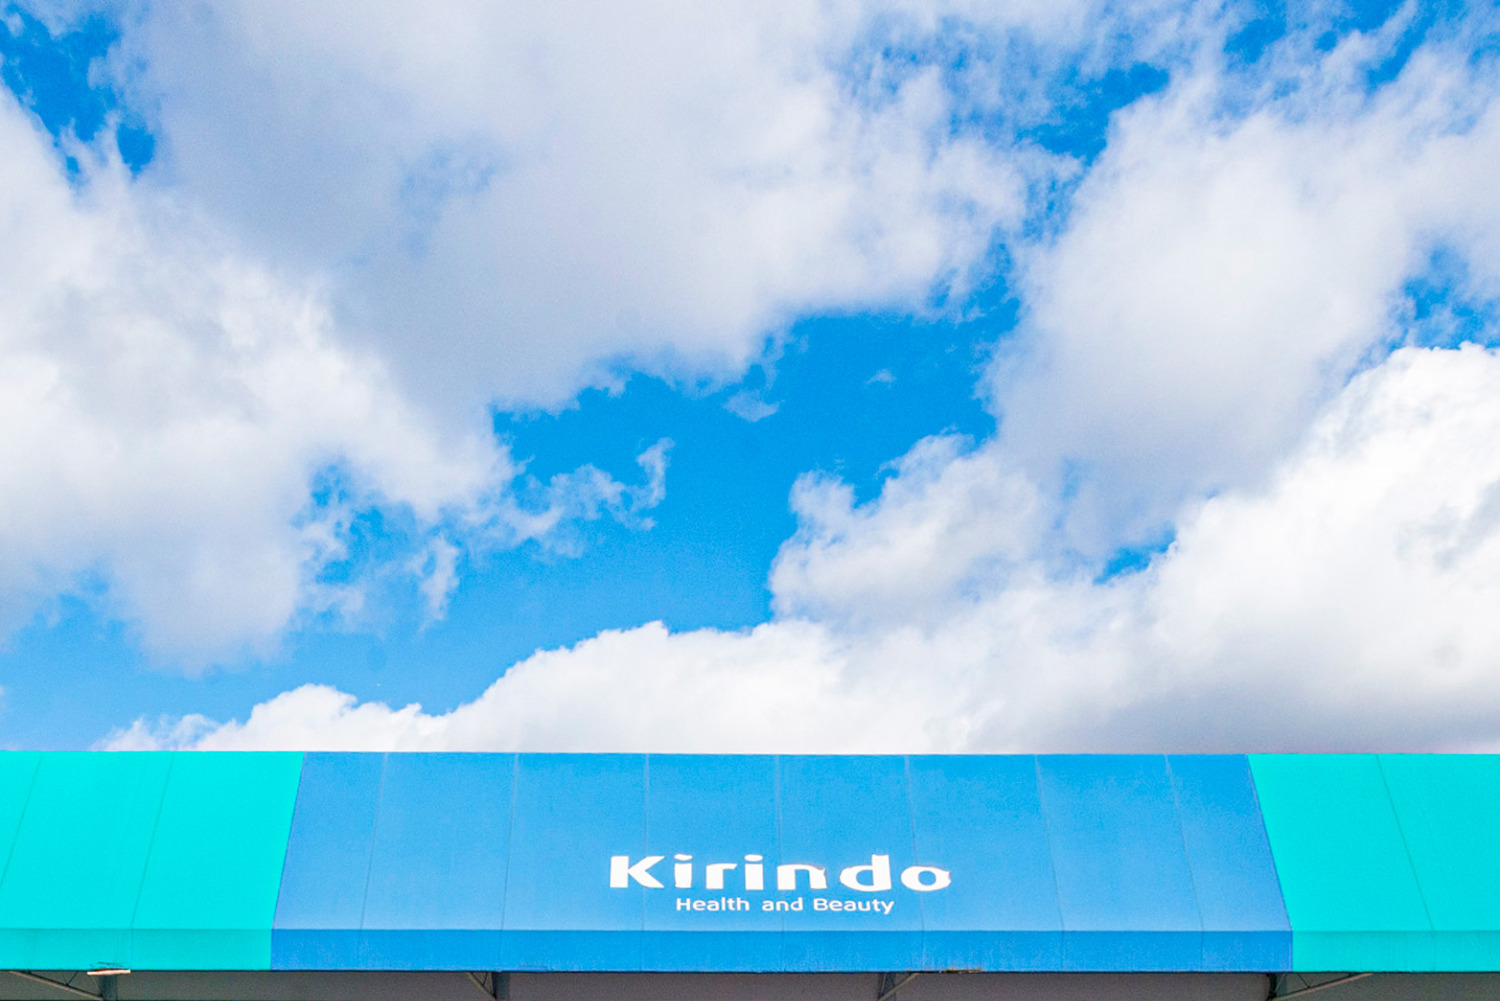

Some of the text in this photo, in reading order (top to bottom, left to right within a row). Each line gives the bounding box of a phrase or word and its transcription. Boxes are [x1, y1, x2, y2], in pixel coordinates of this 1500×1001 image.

[609, 854, 952, 892] Kirindo
[676, 896, 895, 915] Health and Beauty
